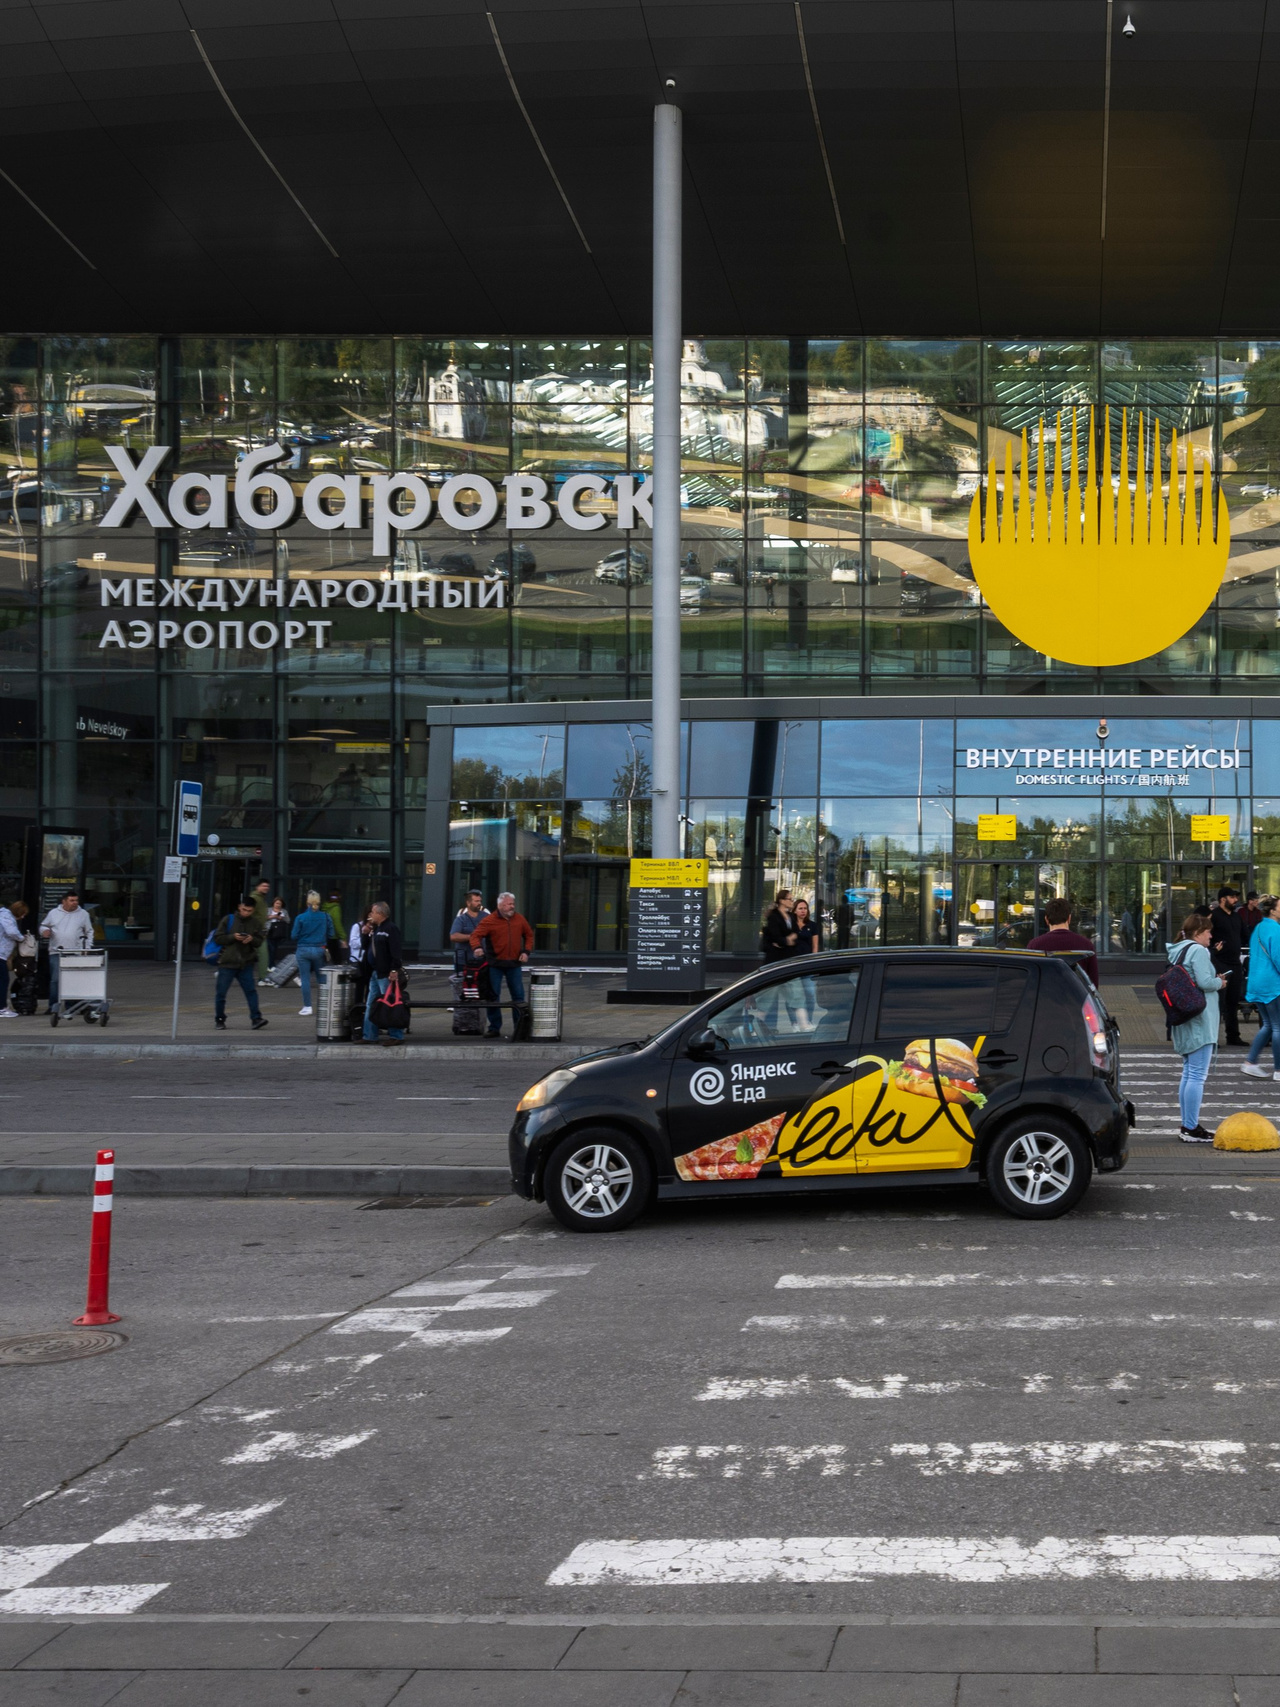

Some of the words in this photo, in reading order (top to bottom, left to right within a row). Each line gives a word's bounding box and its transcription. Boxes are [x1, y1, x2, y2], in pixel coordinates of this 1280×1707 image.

[99, 442, 654, 557] Хабаровск
[101, 575, 504, 612] МЕЖДУНАРОДНЫЙ
[99, 619, 333, 649] АЭРОПОРТ
[87, 718, 127, 740] Nevelskoy
[966, 748, 1142, 769] ВНУТРЕННИЕ
[1150, 744, 1240, 769] РЕЙСЫ
[1016, 774, 1076, 786] DOMESTIC
[1080, 774, 1128, 786] FLIGHTS
[1138, 774, 1190, 787] 国内航班
[638, 914, 670, 922] Троллейбус
[730, 1061, 797, 1082] Яндекс
[732, 1084, 766, 1104] Еда
